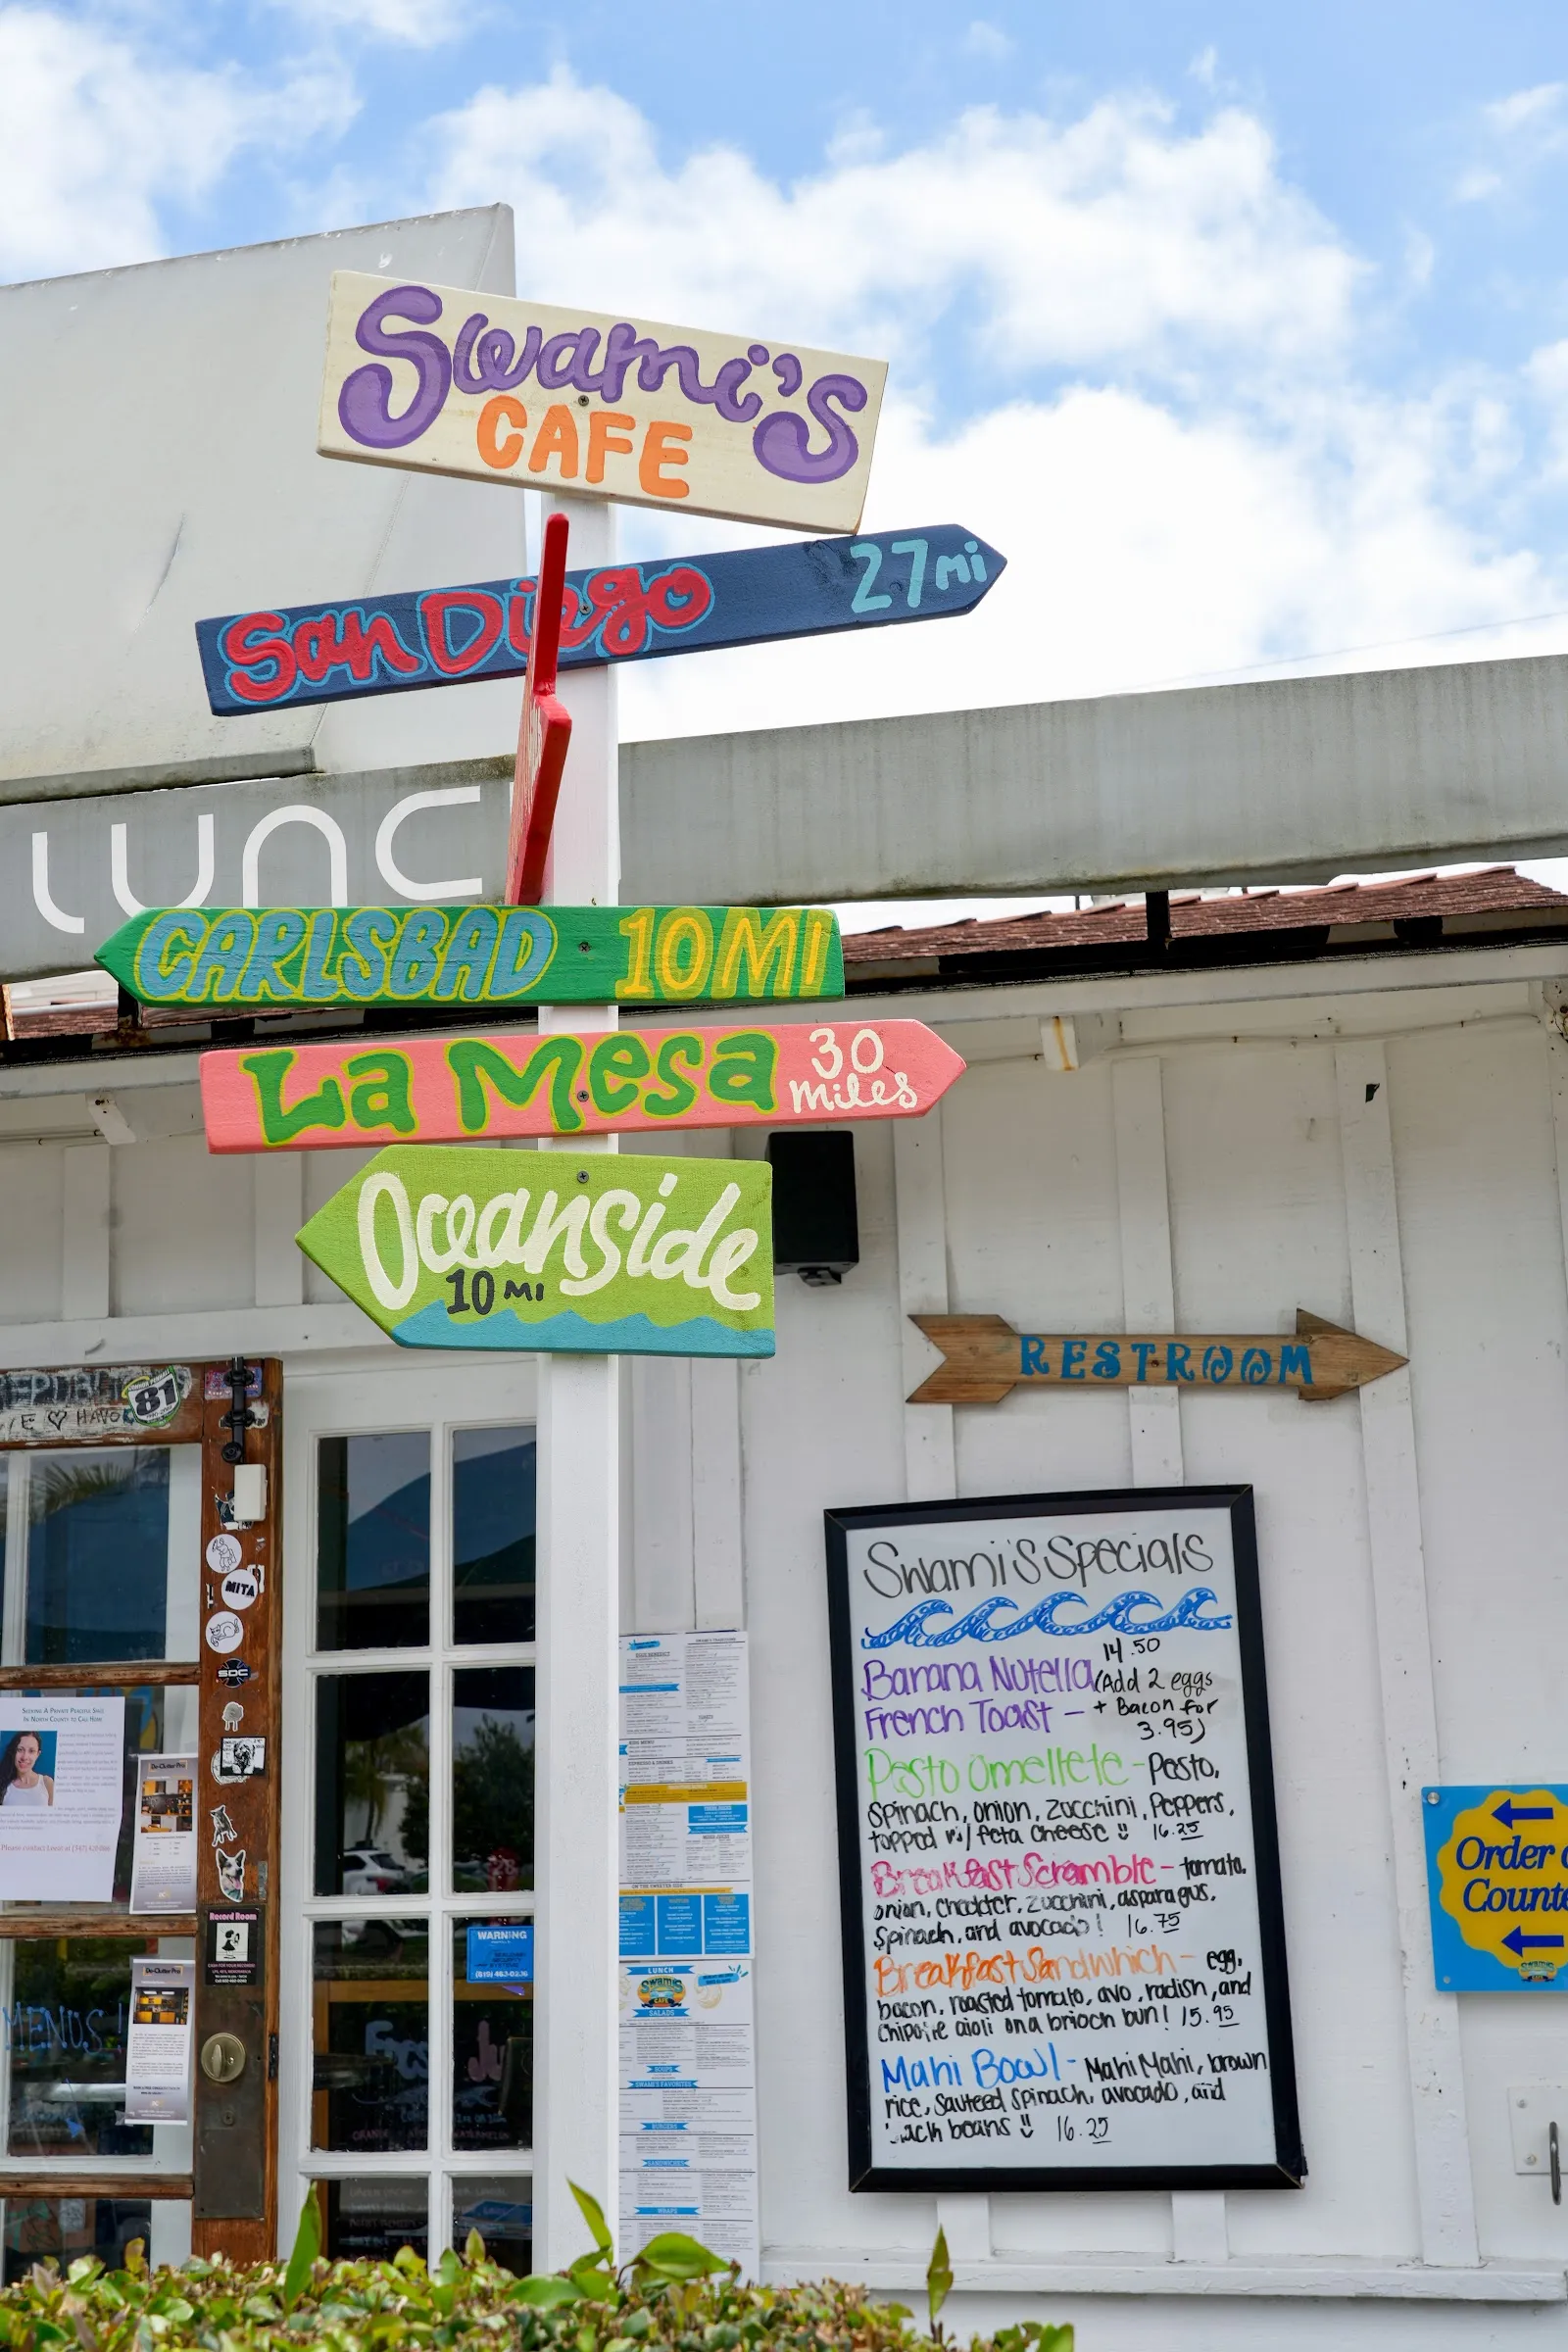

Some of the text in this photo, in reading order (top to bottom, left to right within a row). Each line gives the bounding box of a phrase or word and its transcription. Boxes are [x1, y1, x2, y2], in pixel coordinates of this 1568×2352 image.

[339, 285, 868, 483] Swami's
[476, 395, 693, 498] CAFE
[218, 606, 427, 705] San
[850, 539, 928, 613] 27
[935, 540, 987, 590] mi
[135, 906, 559, 1002] CARLSBAD
[809, 1026, 884, 1080] 30
[239, 1029, 780, 1147] La Mesa
[788, 1072, 918, 1114] miles
[358, 1171, 762, 1312] Oceanside
[446, 1269, 545, 1315] 10 MI
[1020, 1336, 1314, 1386] RESTROOM
[135, 1378, 177, 1416] 81
[225, 1580, 256, 1598] MITA
[1102, 1637, 1160, 1663] 14.50
[218, 1668, 249, 1678] SDC
[861, 1654, 1099, 1700] Banana Nutella
[1148, 1667, 1165, 1690] 2
[1171, 1671, 1213, 1697] eggs
[864, 1697, 1054, 1741] French Toast
[1117, 1696, 1175, 1716] Bacon
[1179, 1698, 1219, 1715] for
[1137, 1717, 1206, 1744] 3.95)
[864, 1748, 960, 1802] Pesto
[868, 1825, 938, 1853] topped
[1152, 1820, 1204, 1840] 16.25
[1455, 1835, 1556, 1870] Order
[870, 1858, 1019, 1898] Breakfast
[1016, 1851, 1157, 1889] Scramble
[209, 1912, 257, 1921] Record Room
[477, 1931, 527, 1939] WARNING
[964, 1918, 1002, 1941] and
[1127, 1911, 1182, 1938] 16.75
[873, 1950, 1019, 1998] Breakfast
[949, 1985, 1015, 2015] roasted
[1218, 1971, 1251, 1996] and
[955, 2017, 994, 2038] aioli
[1181, 2004, 1240, 2028] 15.95
[880, 2055, 963, 2093] Mahi
[971, 2041, 1061, 2089] Bowl
[1084, 2051, 1138, 2083] Mahi
[1206, 2052, 1267, 2074] brown
[1191, 2077, 1227, 2101] and
[947, 2116, 1011, 2140] beans
